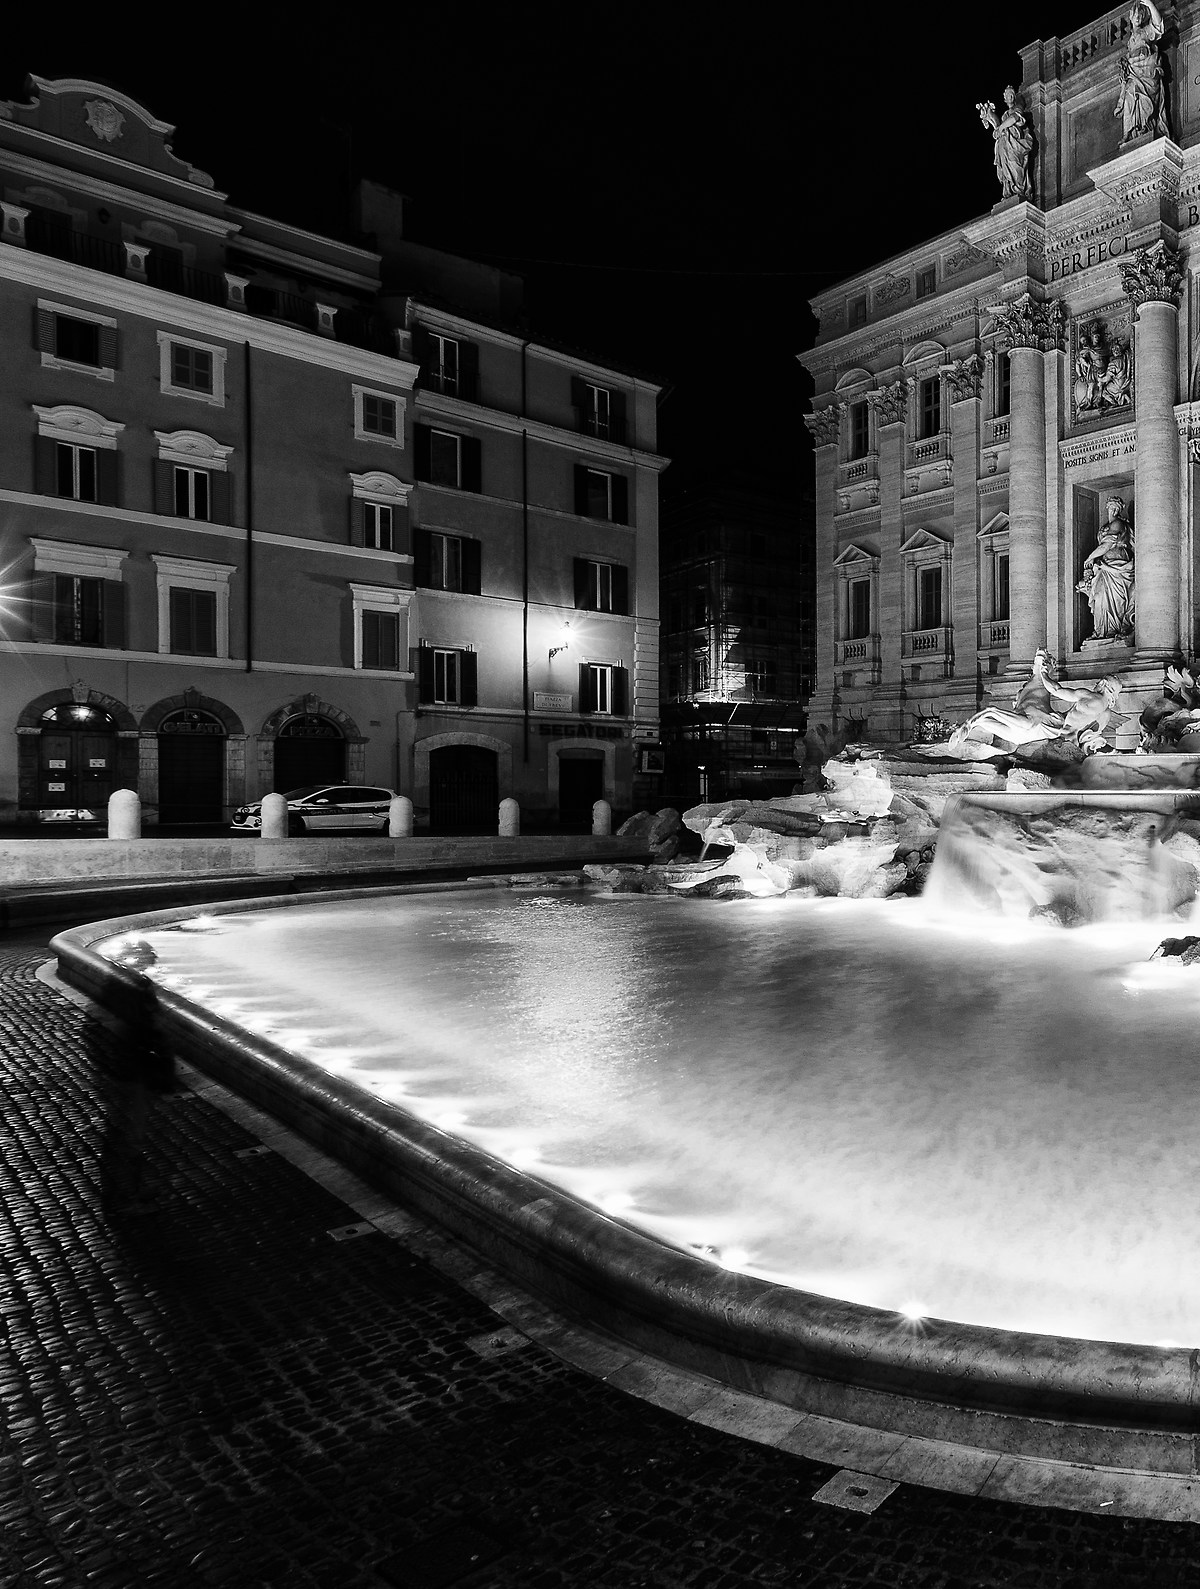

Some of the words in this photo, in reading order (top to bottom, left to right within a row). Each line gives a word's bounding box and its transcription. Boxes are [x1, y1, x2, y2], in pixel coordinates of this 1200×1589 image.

[1065, 456, 1087, 469] POSITIS
[1089, 451, 1109, 463] SIGNIS
[1112, 448, 1121, 457] ET
